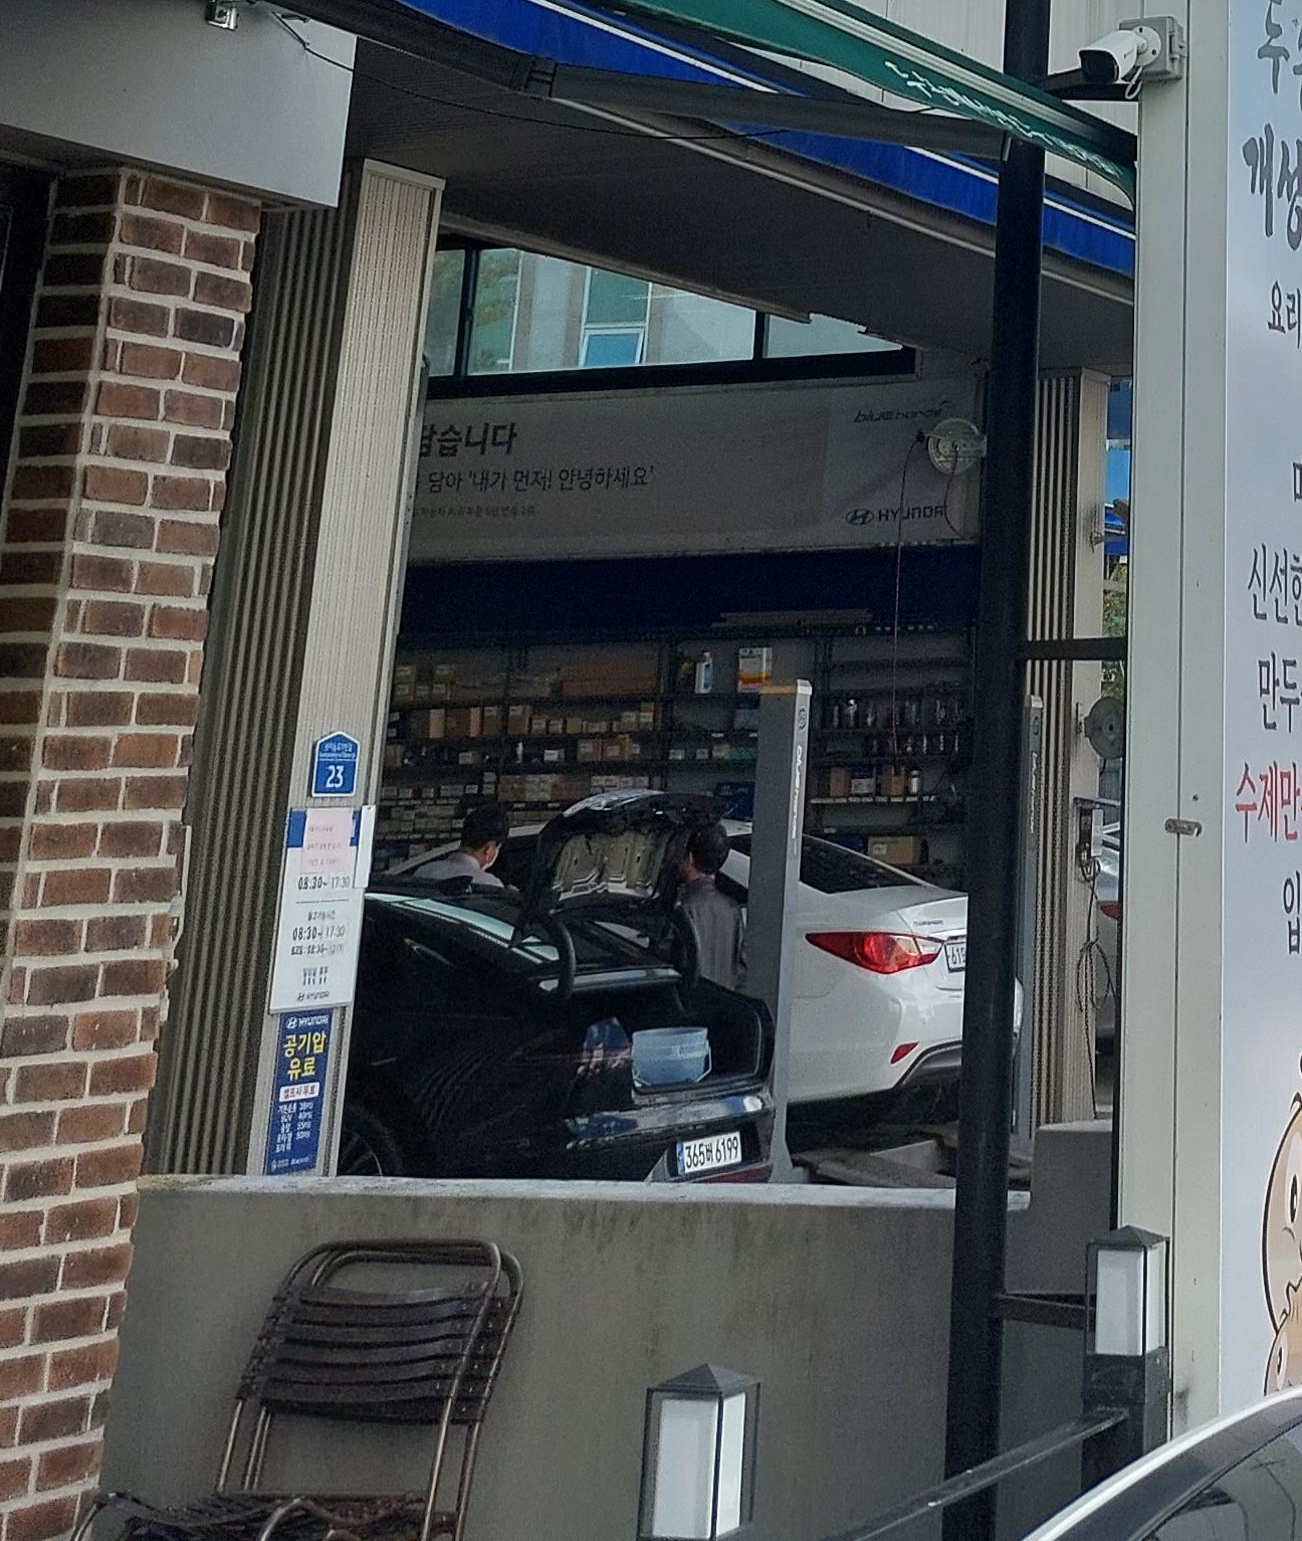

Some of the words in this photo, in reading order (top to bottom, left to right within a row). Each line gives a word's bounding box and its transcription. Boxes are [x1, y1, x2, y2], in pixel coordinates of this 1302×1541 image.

[878, 505, 946, 522] HYUNDA
[326, 765, 345, 788] 23
[283, 1031, 326, 1057] 공기압
[287, 1057, 316, 1081] 유료
[716, 1136, 739, 1163] 6199
